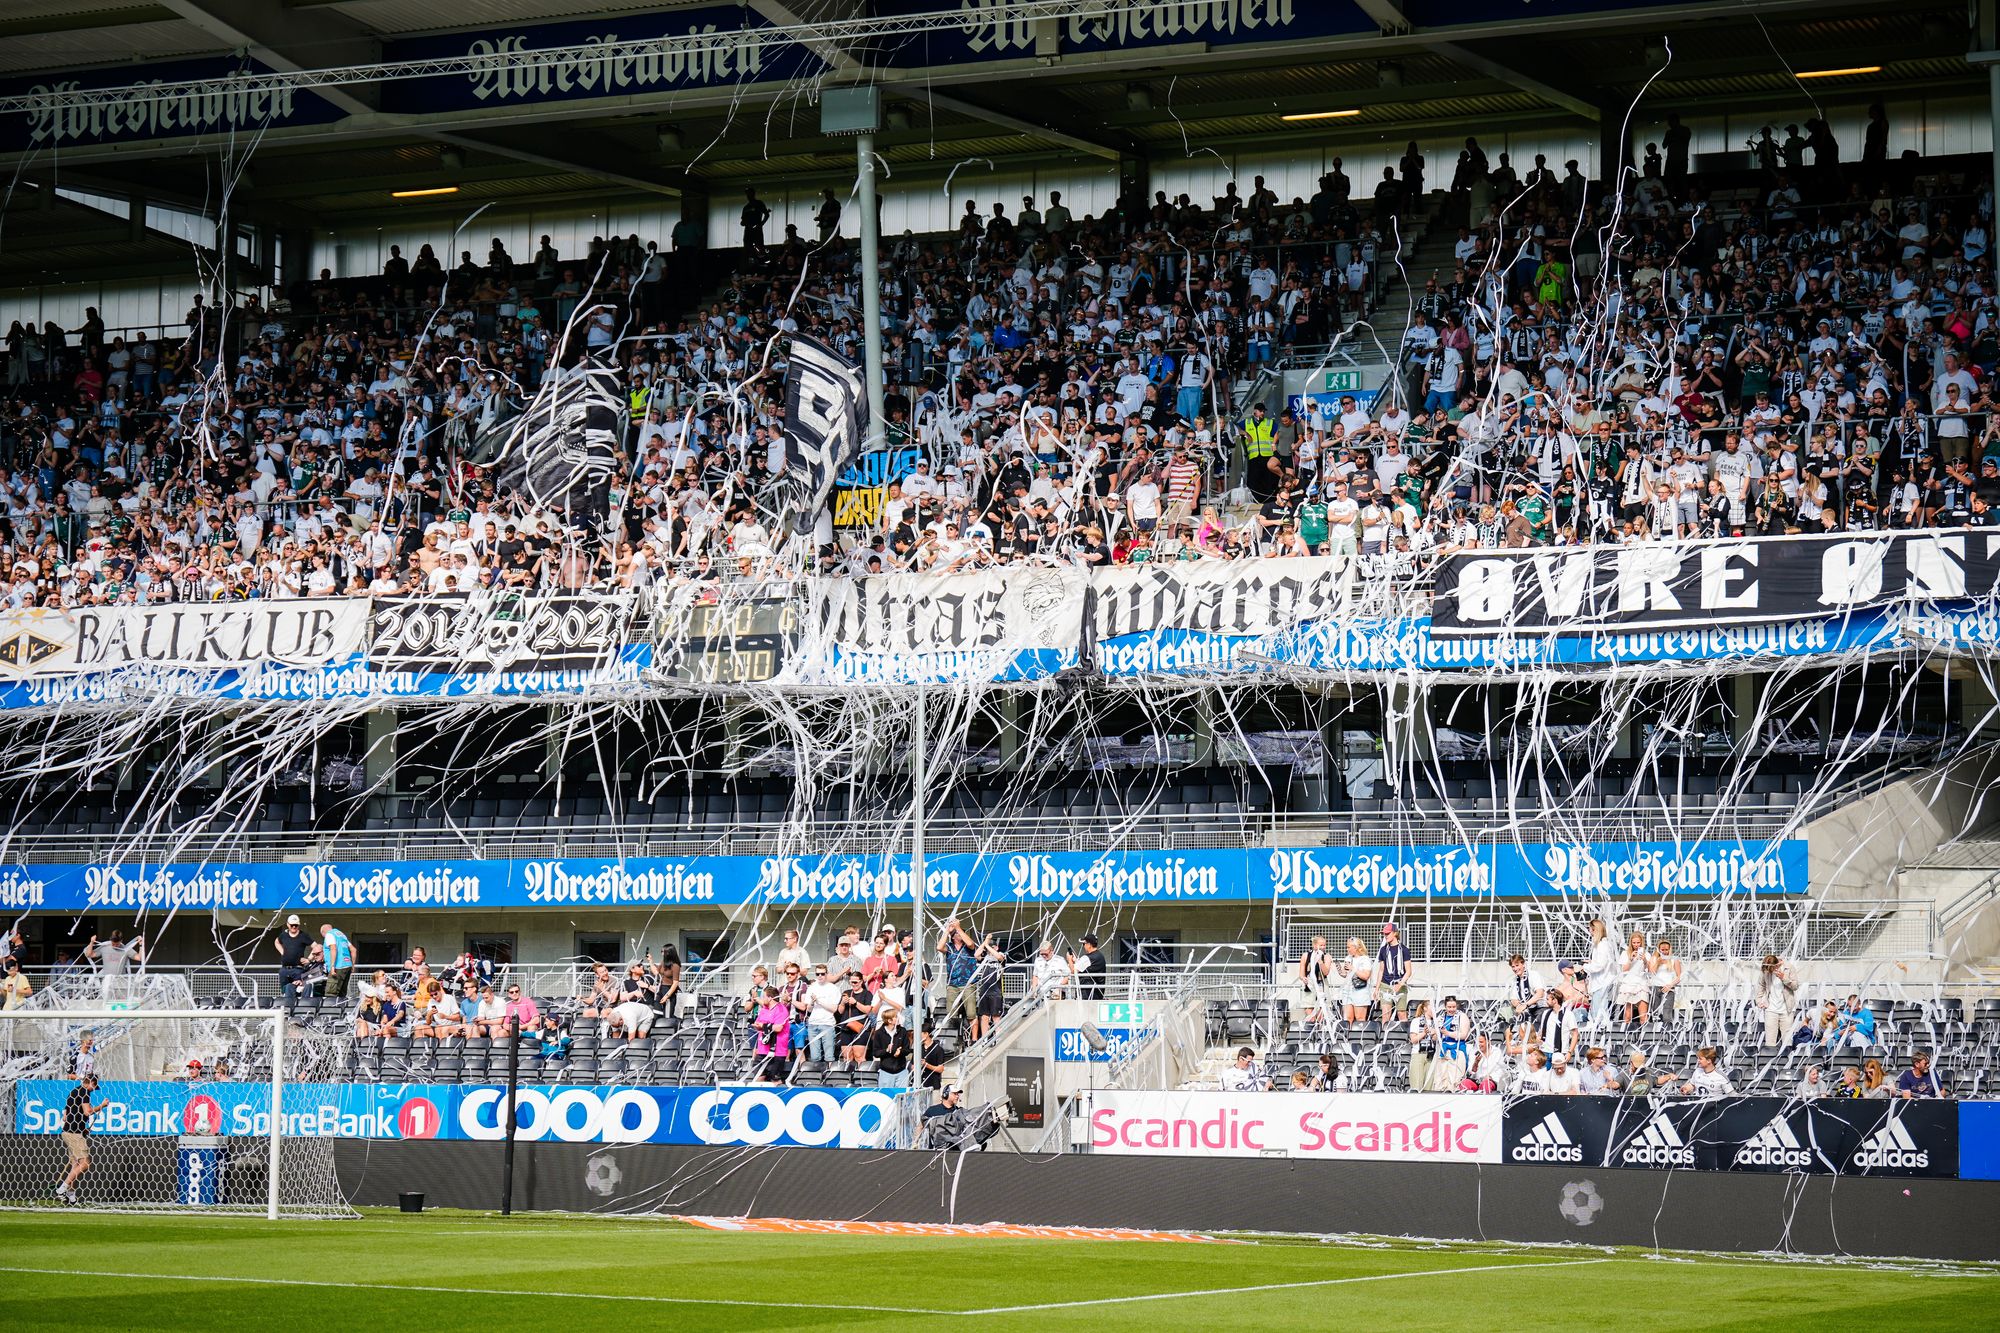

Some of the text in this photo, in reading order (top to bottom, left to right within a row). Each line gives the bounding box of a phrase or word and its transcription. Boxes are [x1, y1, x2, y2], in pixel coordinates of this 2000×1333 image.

[467, 25, 763, 101] Adresseavisen
[1457, 545, 1760, 622] ØVRE
[73, 608, 336, 664] BALLKLUB
[0, 872, 44, 908] isen
[85, 865, 259, 909] Adresseavisen
[299, 863, 481, 906] Adresseavisen
[524, 861, 715, 904] Adresseavisen
[760, 858, 961, 902] Adresseavisen
[1008, 855, 1219, 899] Adresseavisen
[1269, 850, 1492, 897] Adresseavisen
[1544, 845, 1785, 894] Adresseavisen
[24, 1100, 181, 1135] SpeBank
[410, 1105, 426, 1136] 1
[459, 1088, 898, 1150] coop coop
[1092, 1107, 1480, 1154] Scandic Scandic
[1512, 1142, 1579, 1162] adidas
[1623, 1143, 1692, 1164] adidas
[1739, 1145, 1809, 1166] adidas
[1853, 1147, 1926, 1168] adidas
